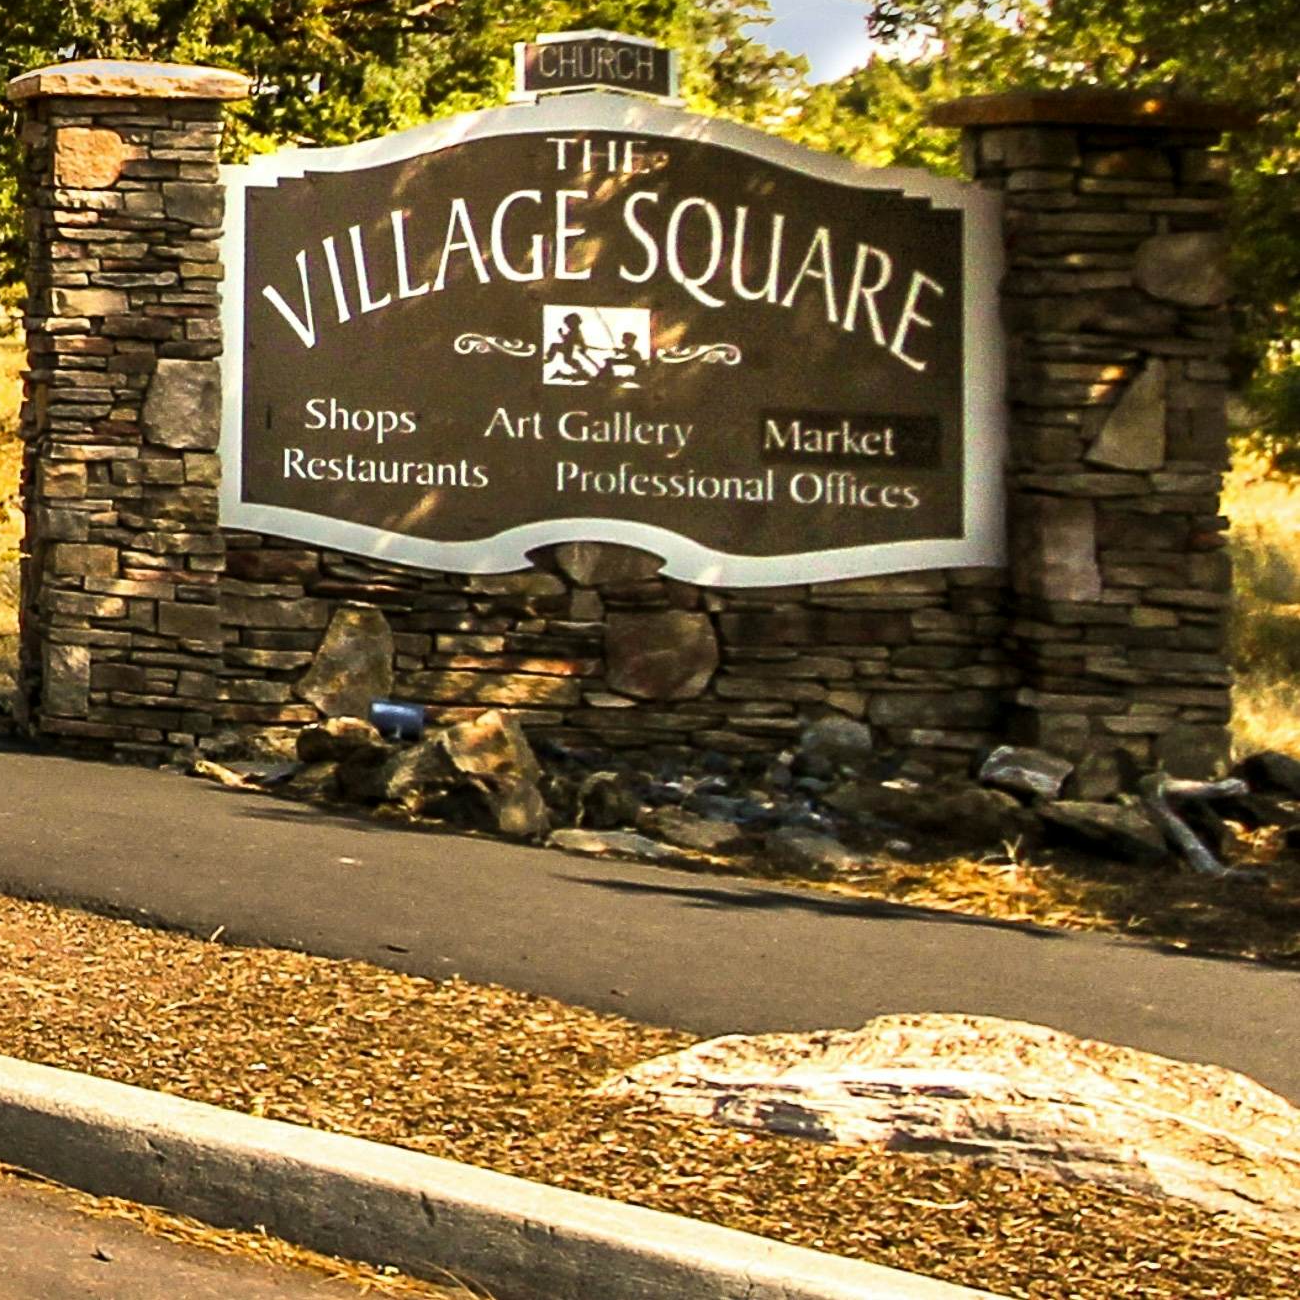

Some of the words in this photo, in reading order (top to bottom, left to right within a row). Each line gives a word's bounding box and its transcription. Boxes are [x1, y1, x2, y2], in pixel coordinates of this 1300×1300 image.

[538, 45, 654, 81] CHURCH
[546, 137, 650, 173] THE
[262, 190, 591, 348] VILLAGE
[619, 191, 944, 372] SQUARE
[305, 398, 417, 444] Shops
[484, 407, 544, 440] Art
[558, 411, 693, 459] Gallery
[764, 419, 896, 456] Market
[283, 448, 489, 488] Restaurants
[556, 461, 774, 502] Professional
[790, 472, 921, 510] Offices
